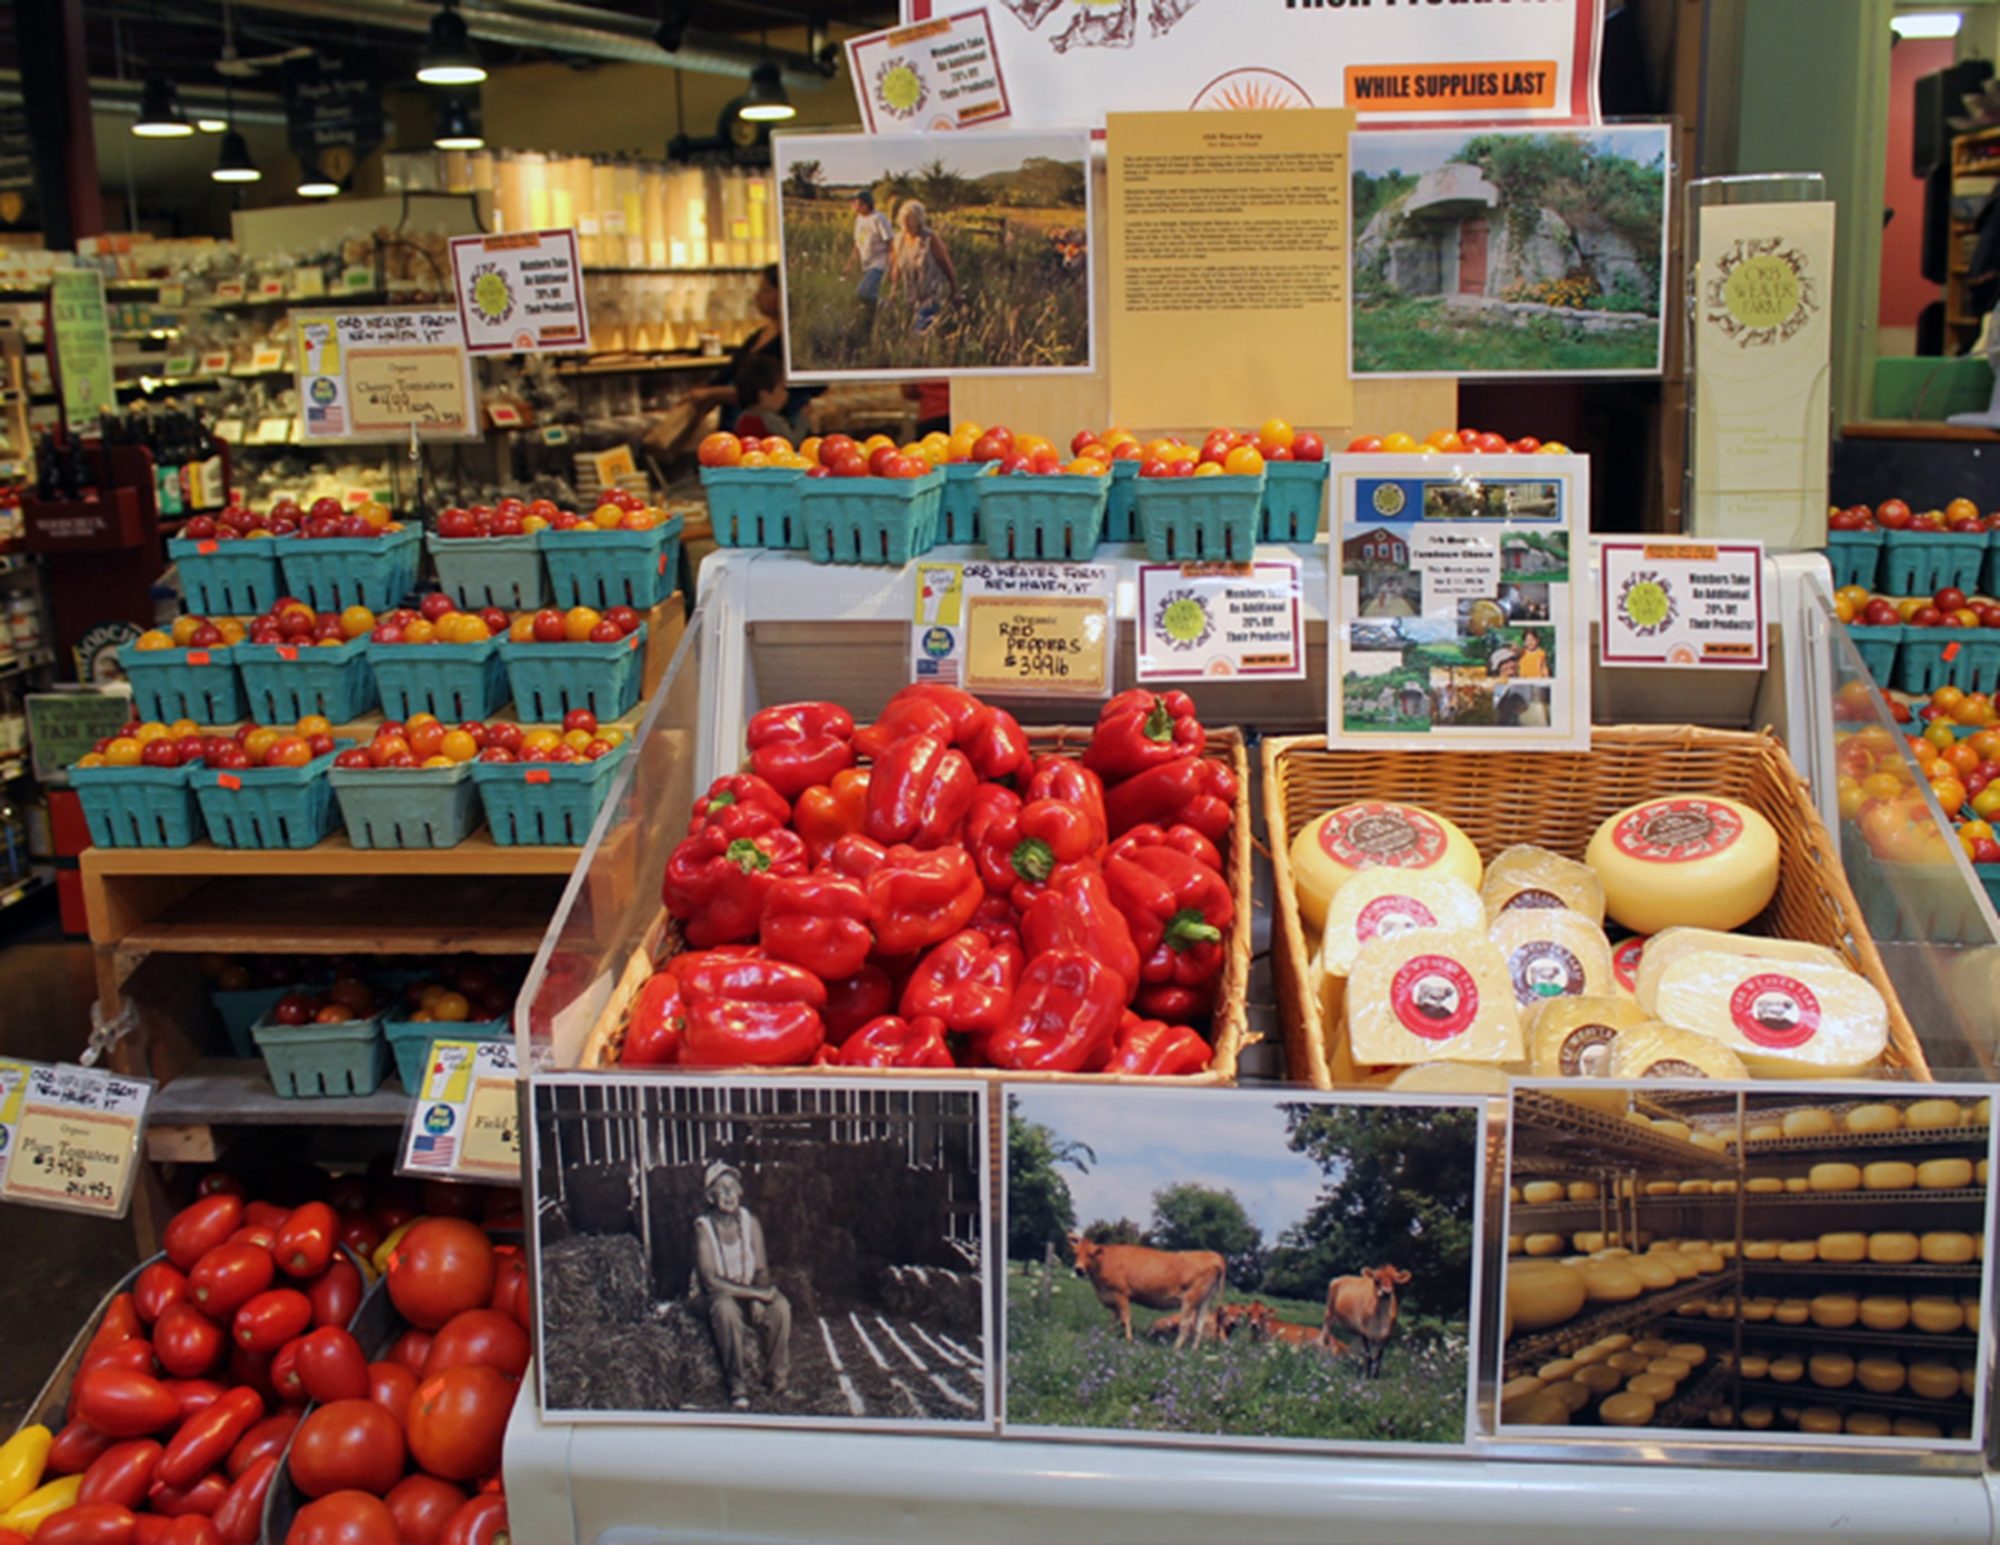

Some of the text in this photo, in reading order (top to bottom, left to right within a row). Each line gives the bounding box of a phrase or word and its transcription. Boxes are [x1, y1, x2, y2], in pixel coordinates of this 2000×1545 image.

[1355, 72, 1545, 99] WHILE SUPPLIES LAST
[1744, 266, 1781, 281] ORB
[1732, 282, 1794, 298] WEAVER
[1742, 299, 1782, 315] FARM
[336, 315, 457, 329] ORB WEAVER FARM
[356, 378, 454, 396] Cherry Tomatoes
[962, 565, 1105, 579] ORB WEAVER FARM
[1689, 573, 1750, 584] Members Take
[985, 579, 1016, 590] NEW
[1075, 582, 1092, 593] VT
[1225, 588, 1265, 599] Members
[1692, 588, 1750, 600] An Additional
[1229, 602, 1285, 614] An Additional
[1705, 604, 1738, 615] 20% Off
[1014, 614, 1056, 626] Organic
[1262, 616, 1274, 627] Off
[1689, 618, 1712, 629] Their
[999, 622, 1034, 637] RED
[1226, 631, 1248, 643] Their
[1007, 635, 1081, 654] PEPPERS
[477, 1045, 510, 1057] ORB
[475, 1115, 509, 1129] Field
[59, 1141, 120, 1165] Tomatoes
